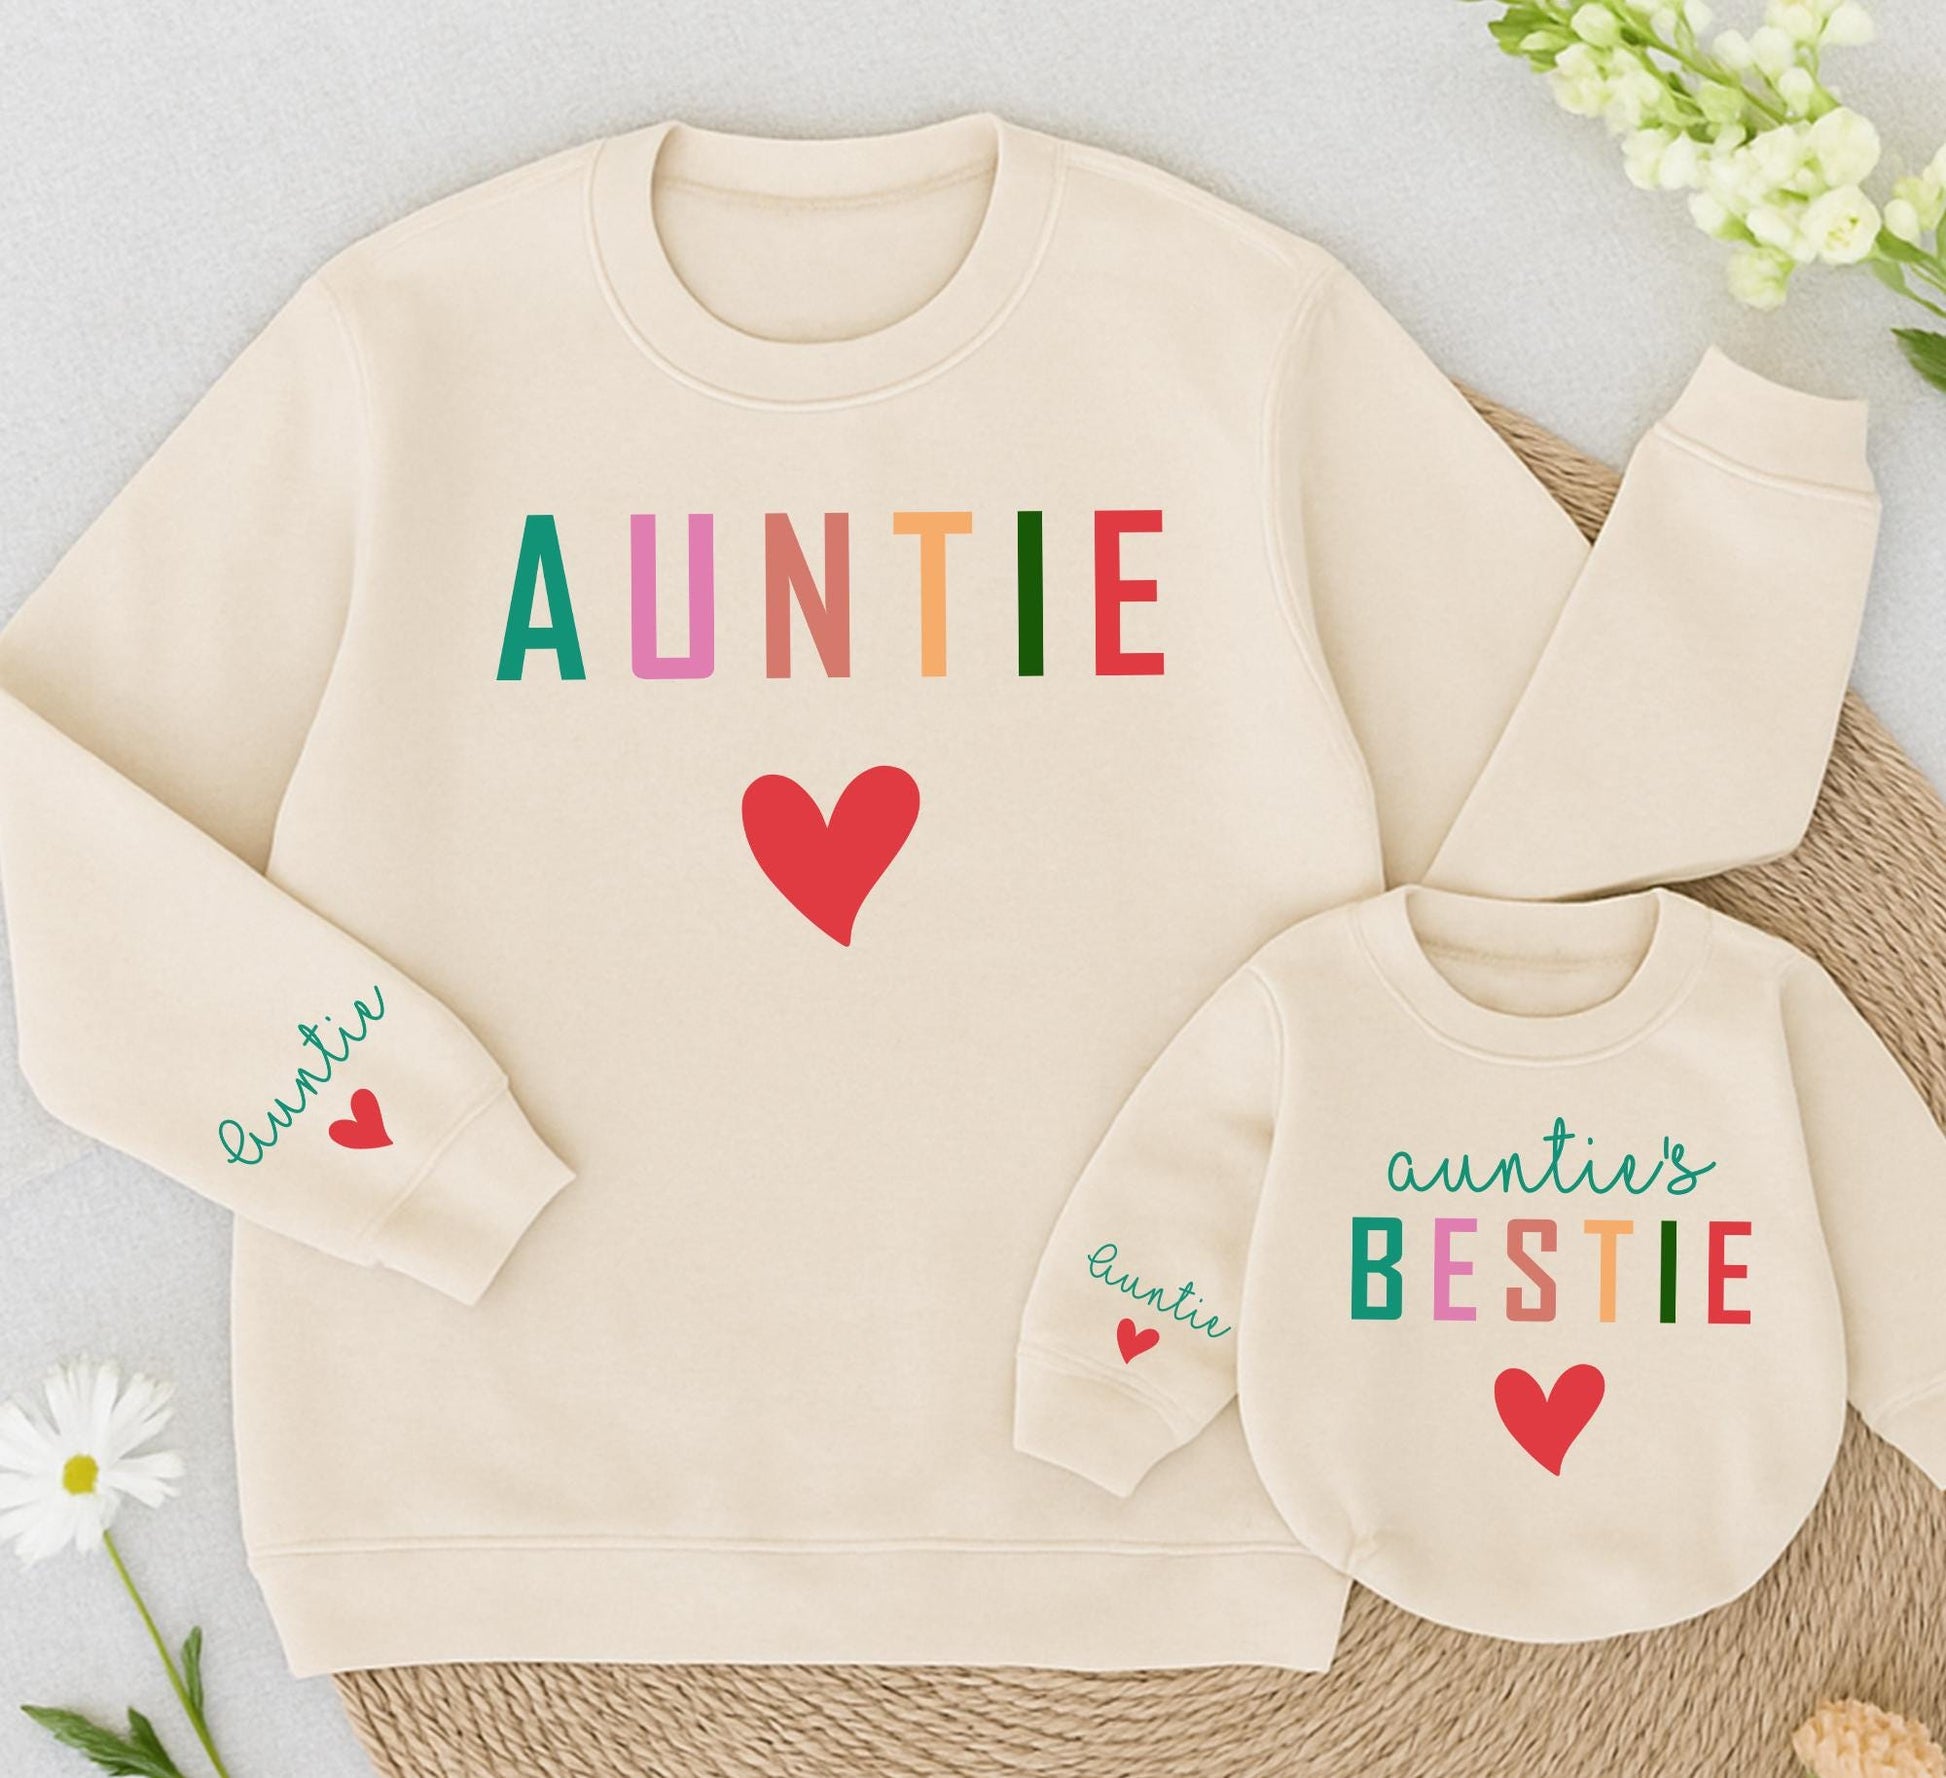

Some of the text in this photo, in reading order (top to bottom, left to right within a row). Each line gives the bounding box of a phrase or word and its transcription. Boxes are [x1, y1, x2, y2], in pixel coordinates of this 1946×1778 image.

[497, 510, 1165, 680] AUNTIE
[1388, 1117, 1716, 1196] auntie's
[1351, 1217, 1752, 1324] BESTIE
